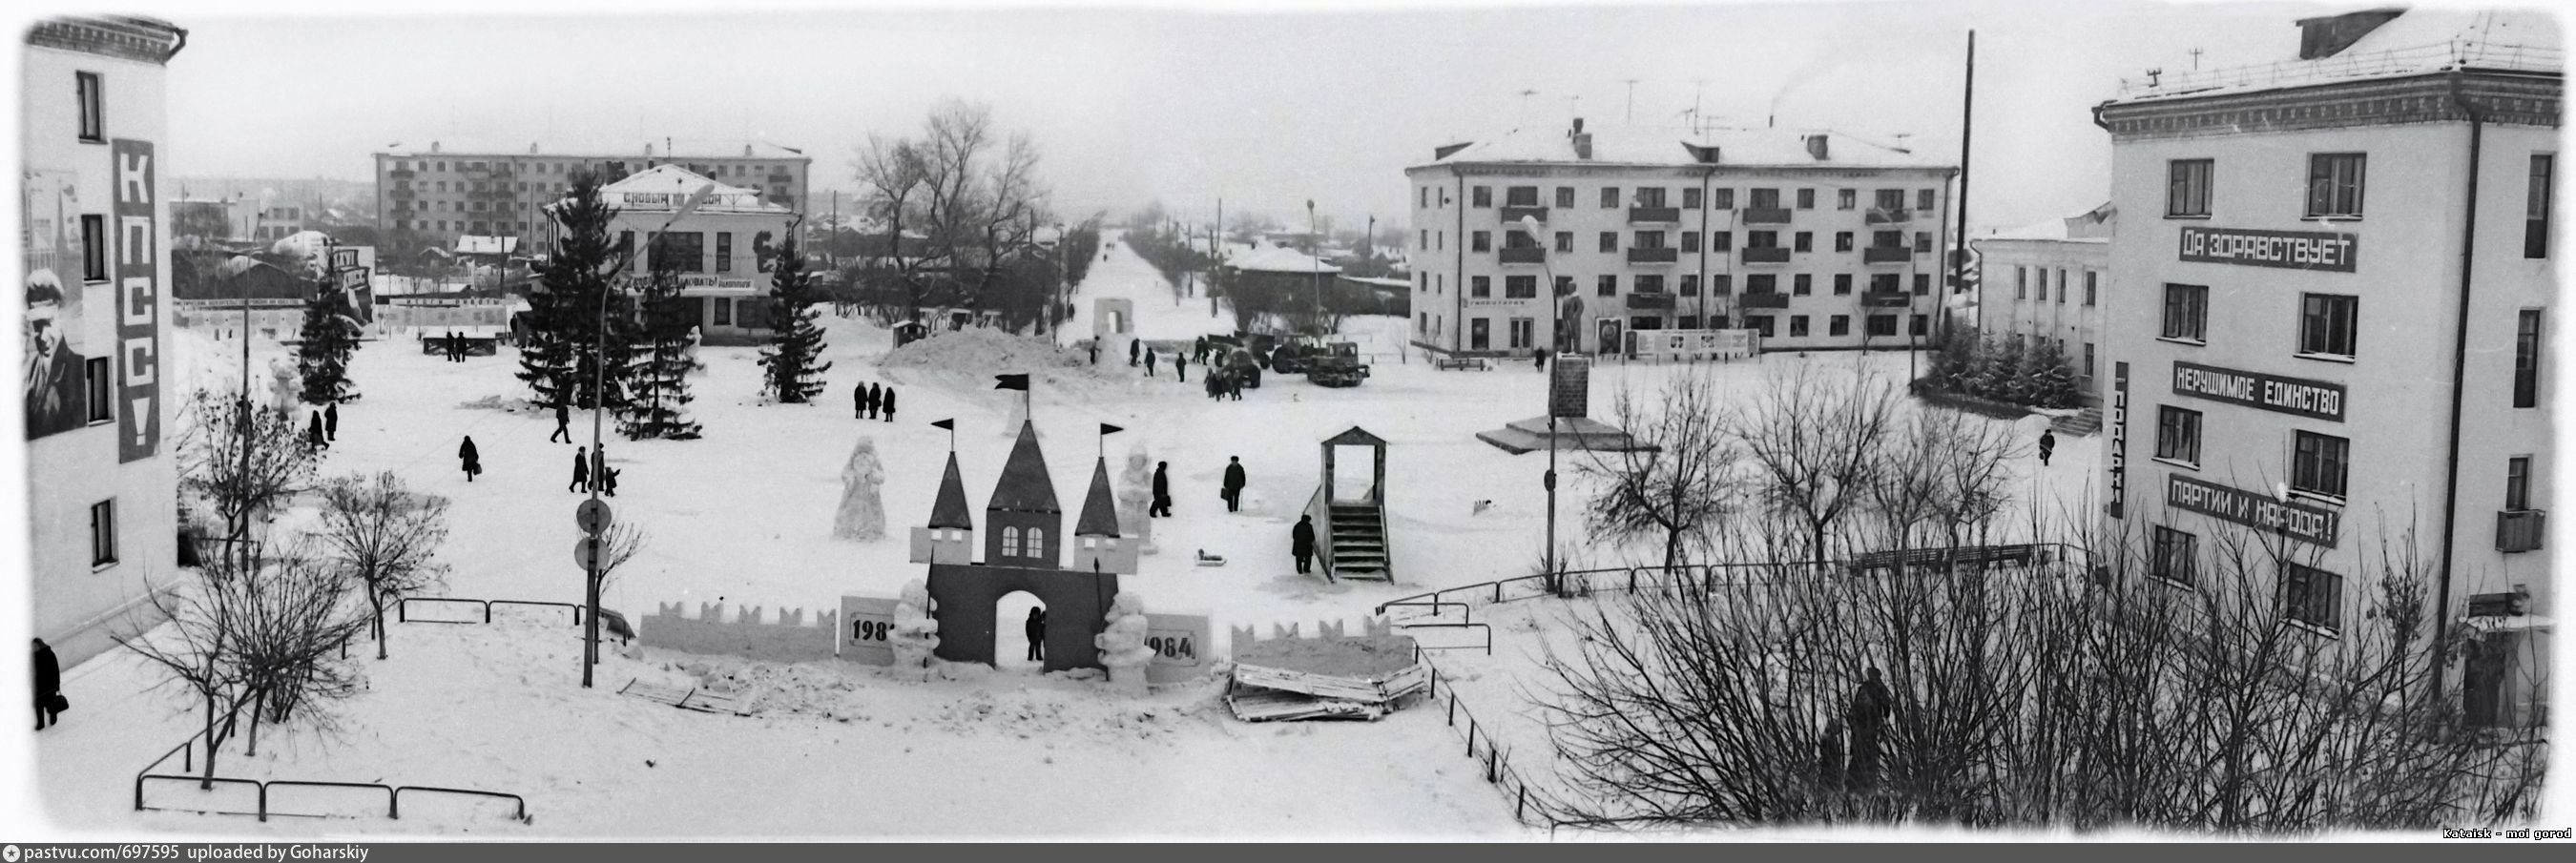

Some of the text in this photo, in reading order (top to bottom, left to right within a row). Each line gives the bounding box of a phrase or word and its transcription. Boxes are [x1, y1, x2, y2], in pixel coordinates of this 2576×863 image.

[2183, 229, 2350, 266] ДА ЗДРАВСТВУЕТ
[119, 152, 155, 446] КПСС!
[2176, 367, 2339, 415] НЕРУШИМОЕ ЕДИНСТВО
[2171, 480, 2334, 542] ПАРТИИ И НАРОДА!
[853, 619, 895, 642] 198
[1144, 636, 1192, 658] 984
